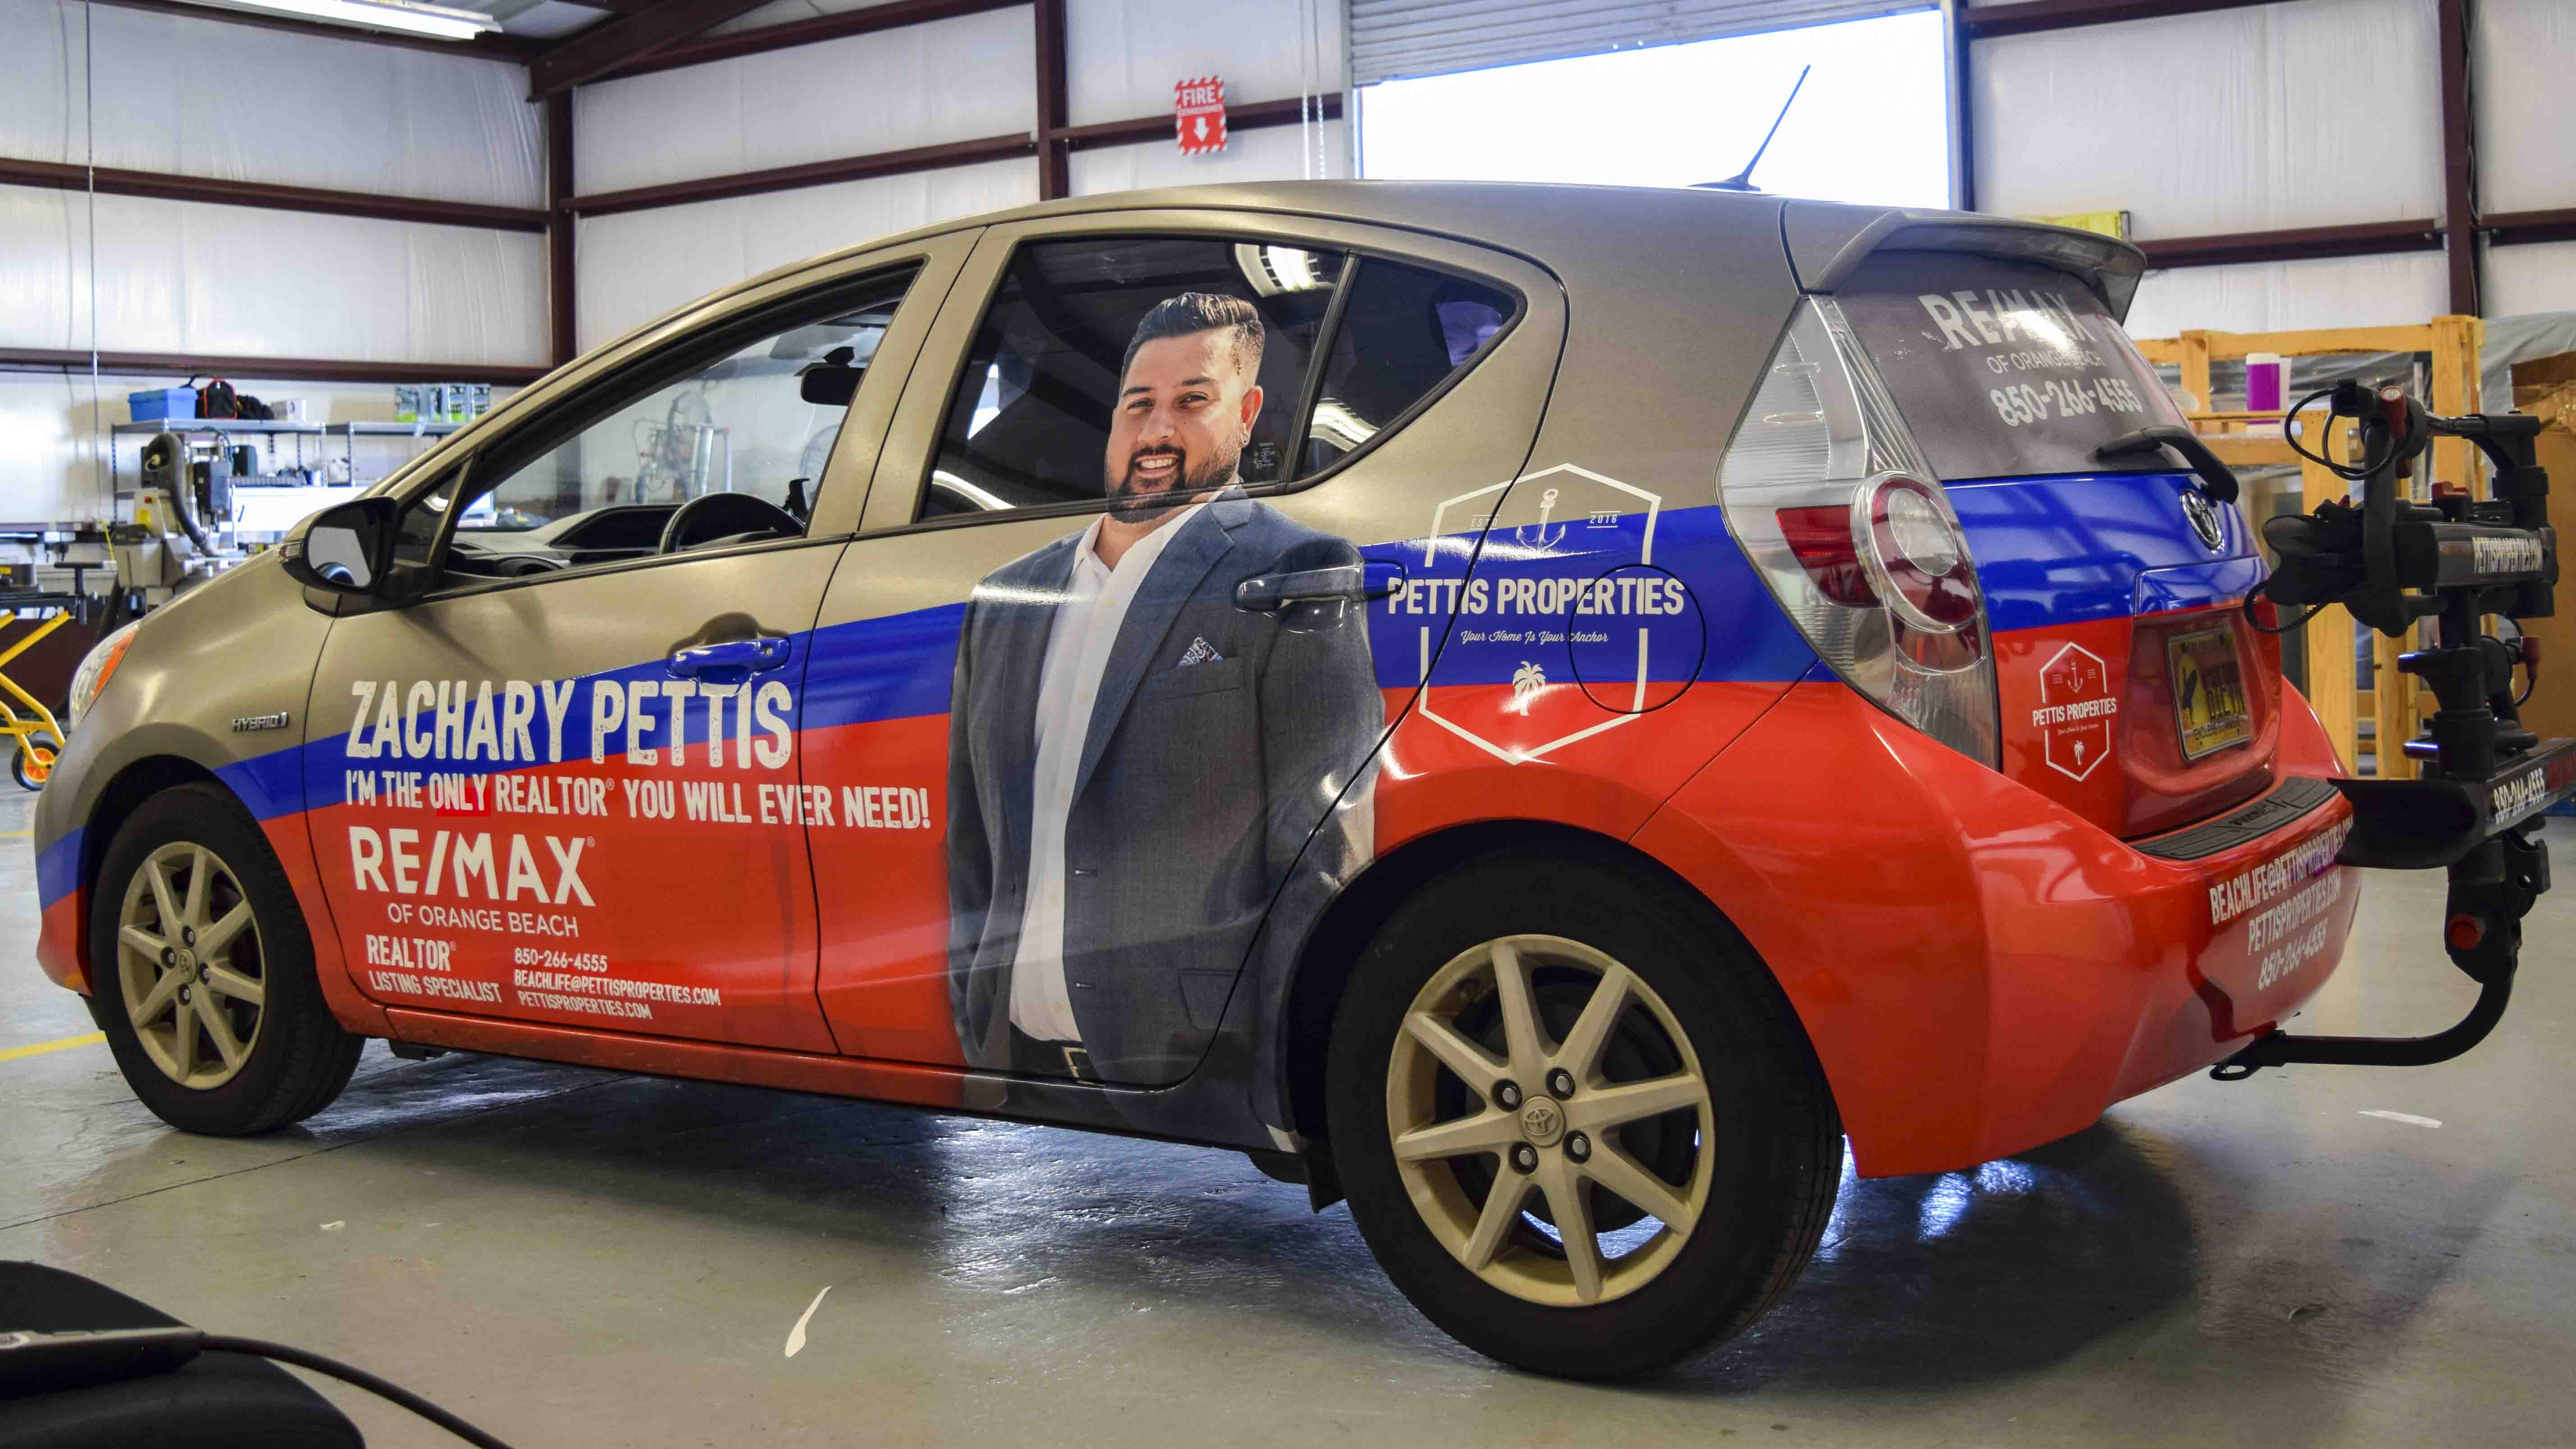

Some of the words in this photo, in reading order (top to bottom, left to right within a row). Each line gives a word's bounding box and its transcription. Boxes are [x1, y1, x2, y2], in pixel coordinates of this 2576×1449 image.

[1182, 87, 1216, 106] FIRE
[1987, 355, 2008, 374] OF
[1990, 378, 2144, 427] 850-266-4555
[1590, 515, 1618, 524] 2016
[1388, 578, 1489, 614] PETTIS
[1497, 578, 1685, 615] PROPERTIES
[1461, 630, 1486, 645] Your
[1489, 630, 1521, 642] Home
[1524, 631, 1536, 645] Is
[1539, 631, 1564, 645] Your
[1568, 631, 1608, 642] Anchor
[232, 715, 278, 732] HYBRID
[346, 680, 575, 762] ZACHARY
[591, 680, 793, 769] PETTIS
[2033, 706, 2065, 728] PETTIS
[2066, 697, 2116, 721] PROPERTIES
[346, 770, 376, 806] I'M
[383, 771, 422, 808] THE
[429, 772, 488, 811] ONLY
[624, 779, 676, 820] YOU
[683, 782, 752, 824] WILL
[759, 784, 835, 827] EVER
[843, 786, 931, 829] NEED!
[2210, 814, 2353, 925] BEACHLIFE@PETTISPROPERTIESCO
[388, 902, 414, 923] OF
[419, 905, 504, 930] ORANGE
[508, 911, 580, 938] BEACH
[514, 947, 608, 973] 850-266-4555
[2258, 917, 2329, 991] 850-266-4555
[368, 970, 423, 995] LISTING
[422, 976, 503, 1003] SPECIALIST
[514, 969, 722, 1006] BEACHLIFE@PETTISPROPERTIES.COM
[518, 990, 653, 1019] PETTISPROPERTIES.COM
